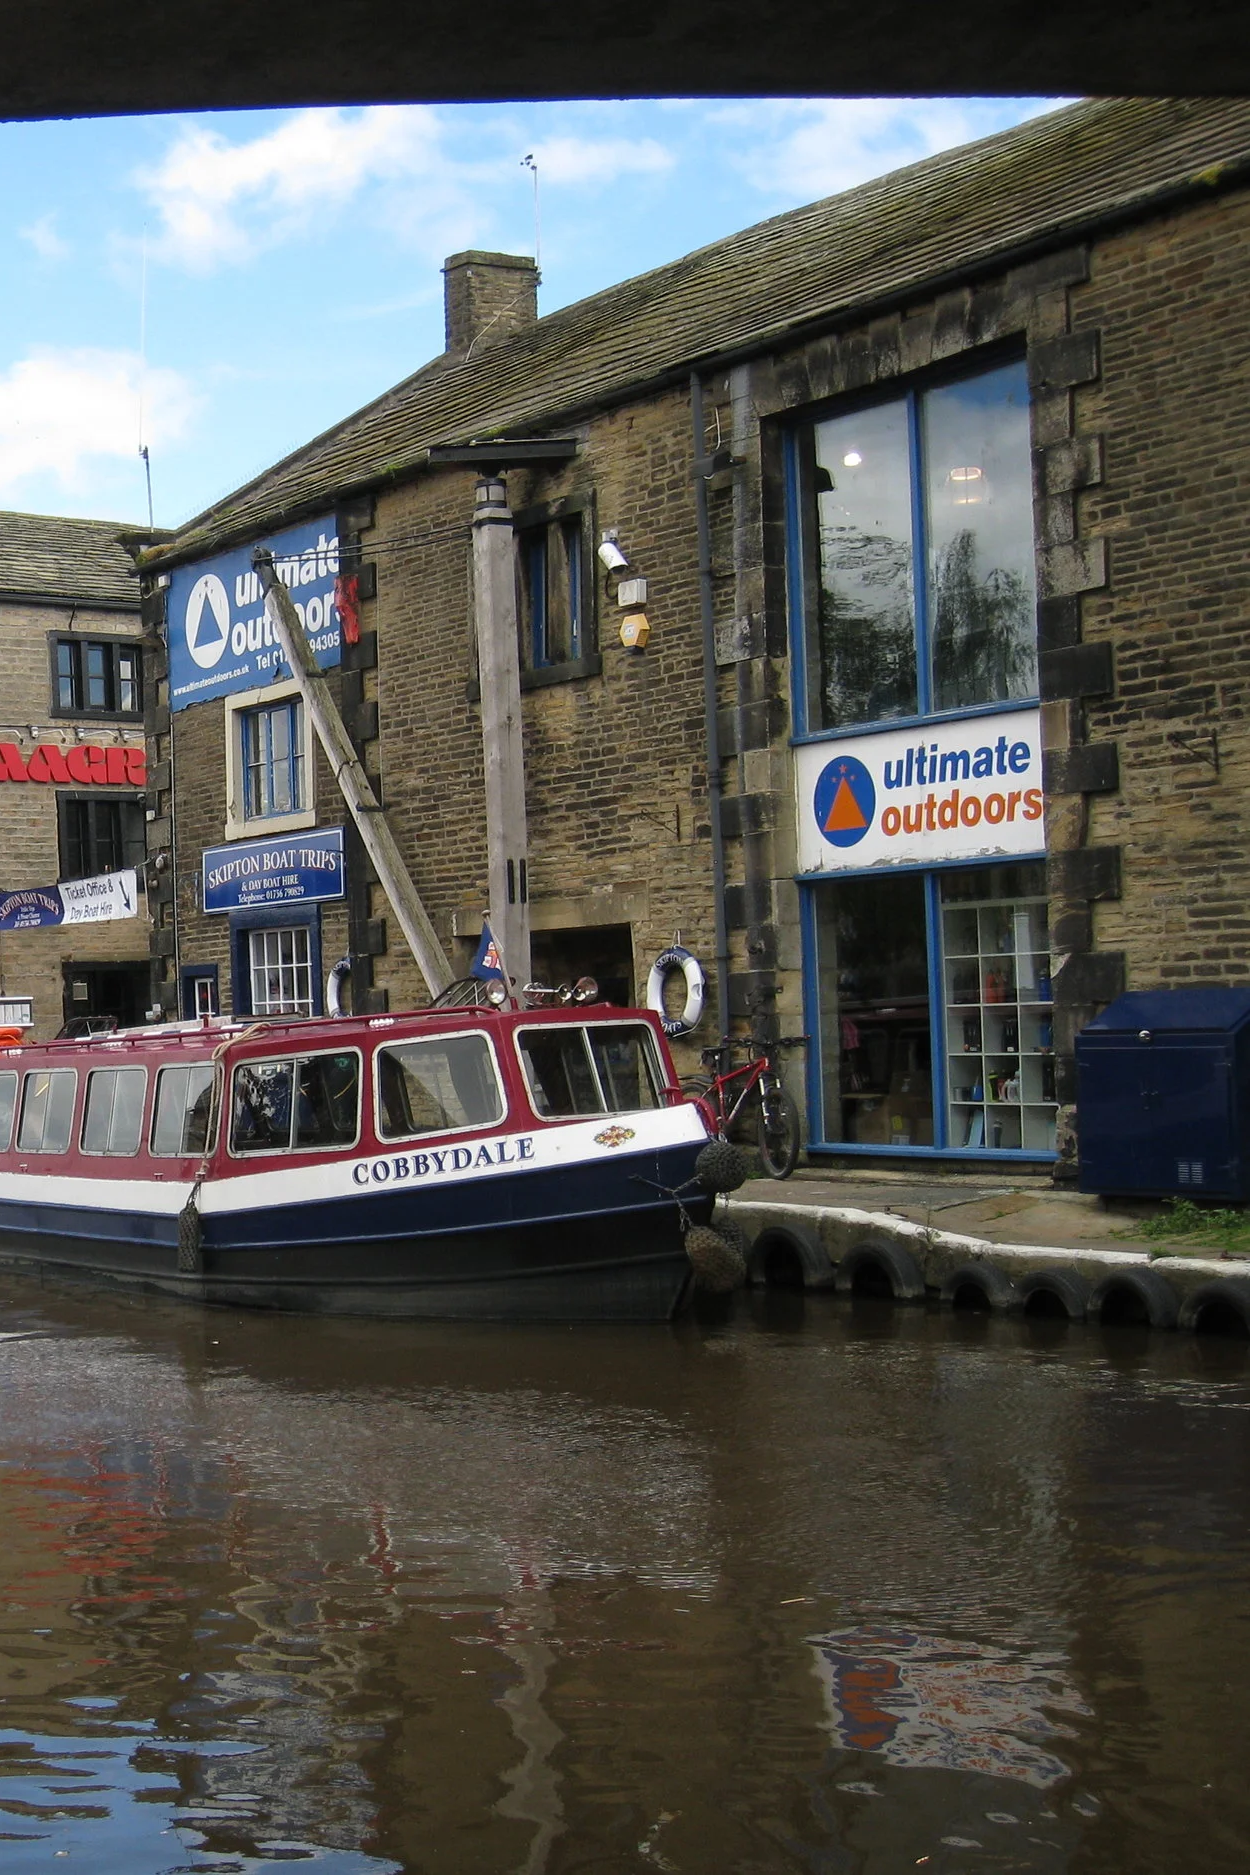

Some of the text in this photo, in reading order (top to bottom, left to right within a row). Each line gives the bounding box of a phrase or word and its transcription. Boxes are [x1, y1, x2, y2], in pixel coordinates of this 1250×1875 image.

[235, 533, 339, 607] ulmate
[255, 652, 270, 671] Tel
[307, 630, 340, 653] 94305
[883, 735, 1031, 790] ultimate
[881, 788, 1044, 837] outdoors
[208, 848, 337, 889] SKIPTON BOAT TRIPS
[241, 873, 299, 892] & DAY BOAT HIRE
[65, 878, 114, 901] Ticket Office &
[265, 888, 284, 900] 01756
[70, 901, 113, 920] Day Boat Hire
[351, 1136, 536, 1187] COBBYDALE
